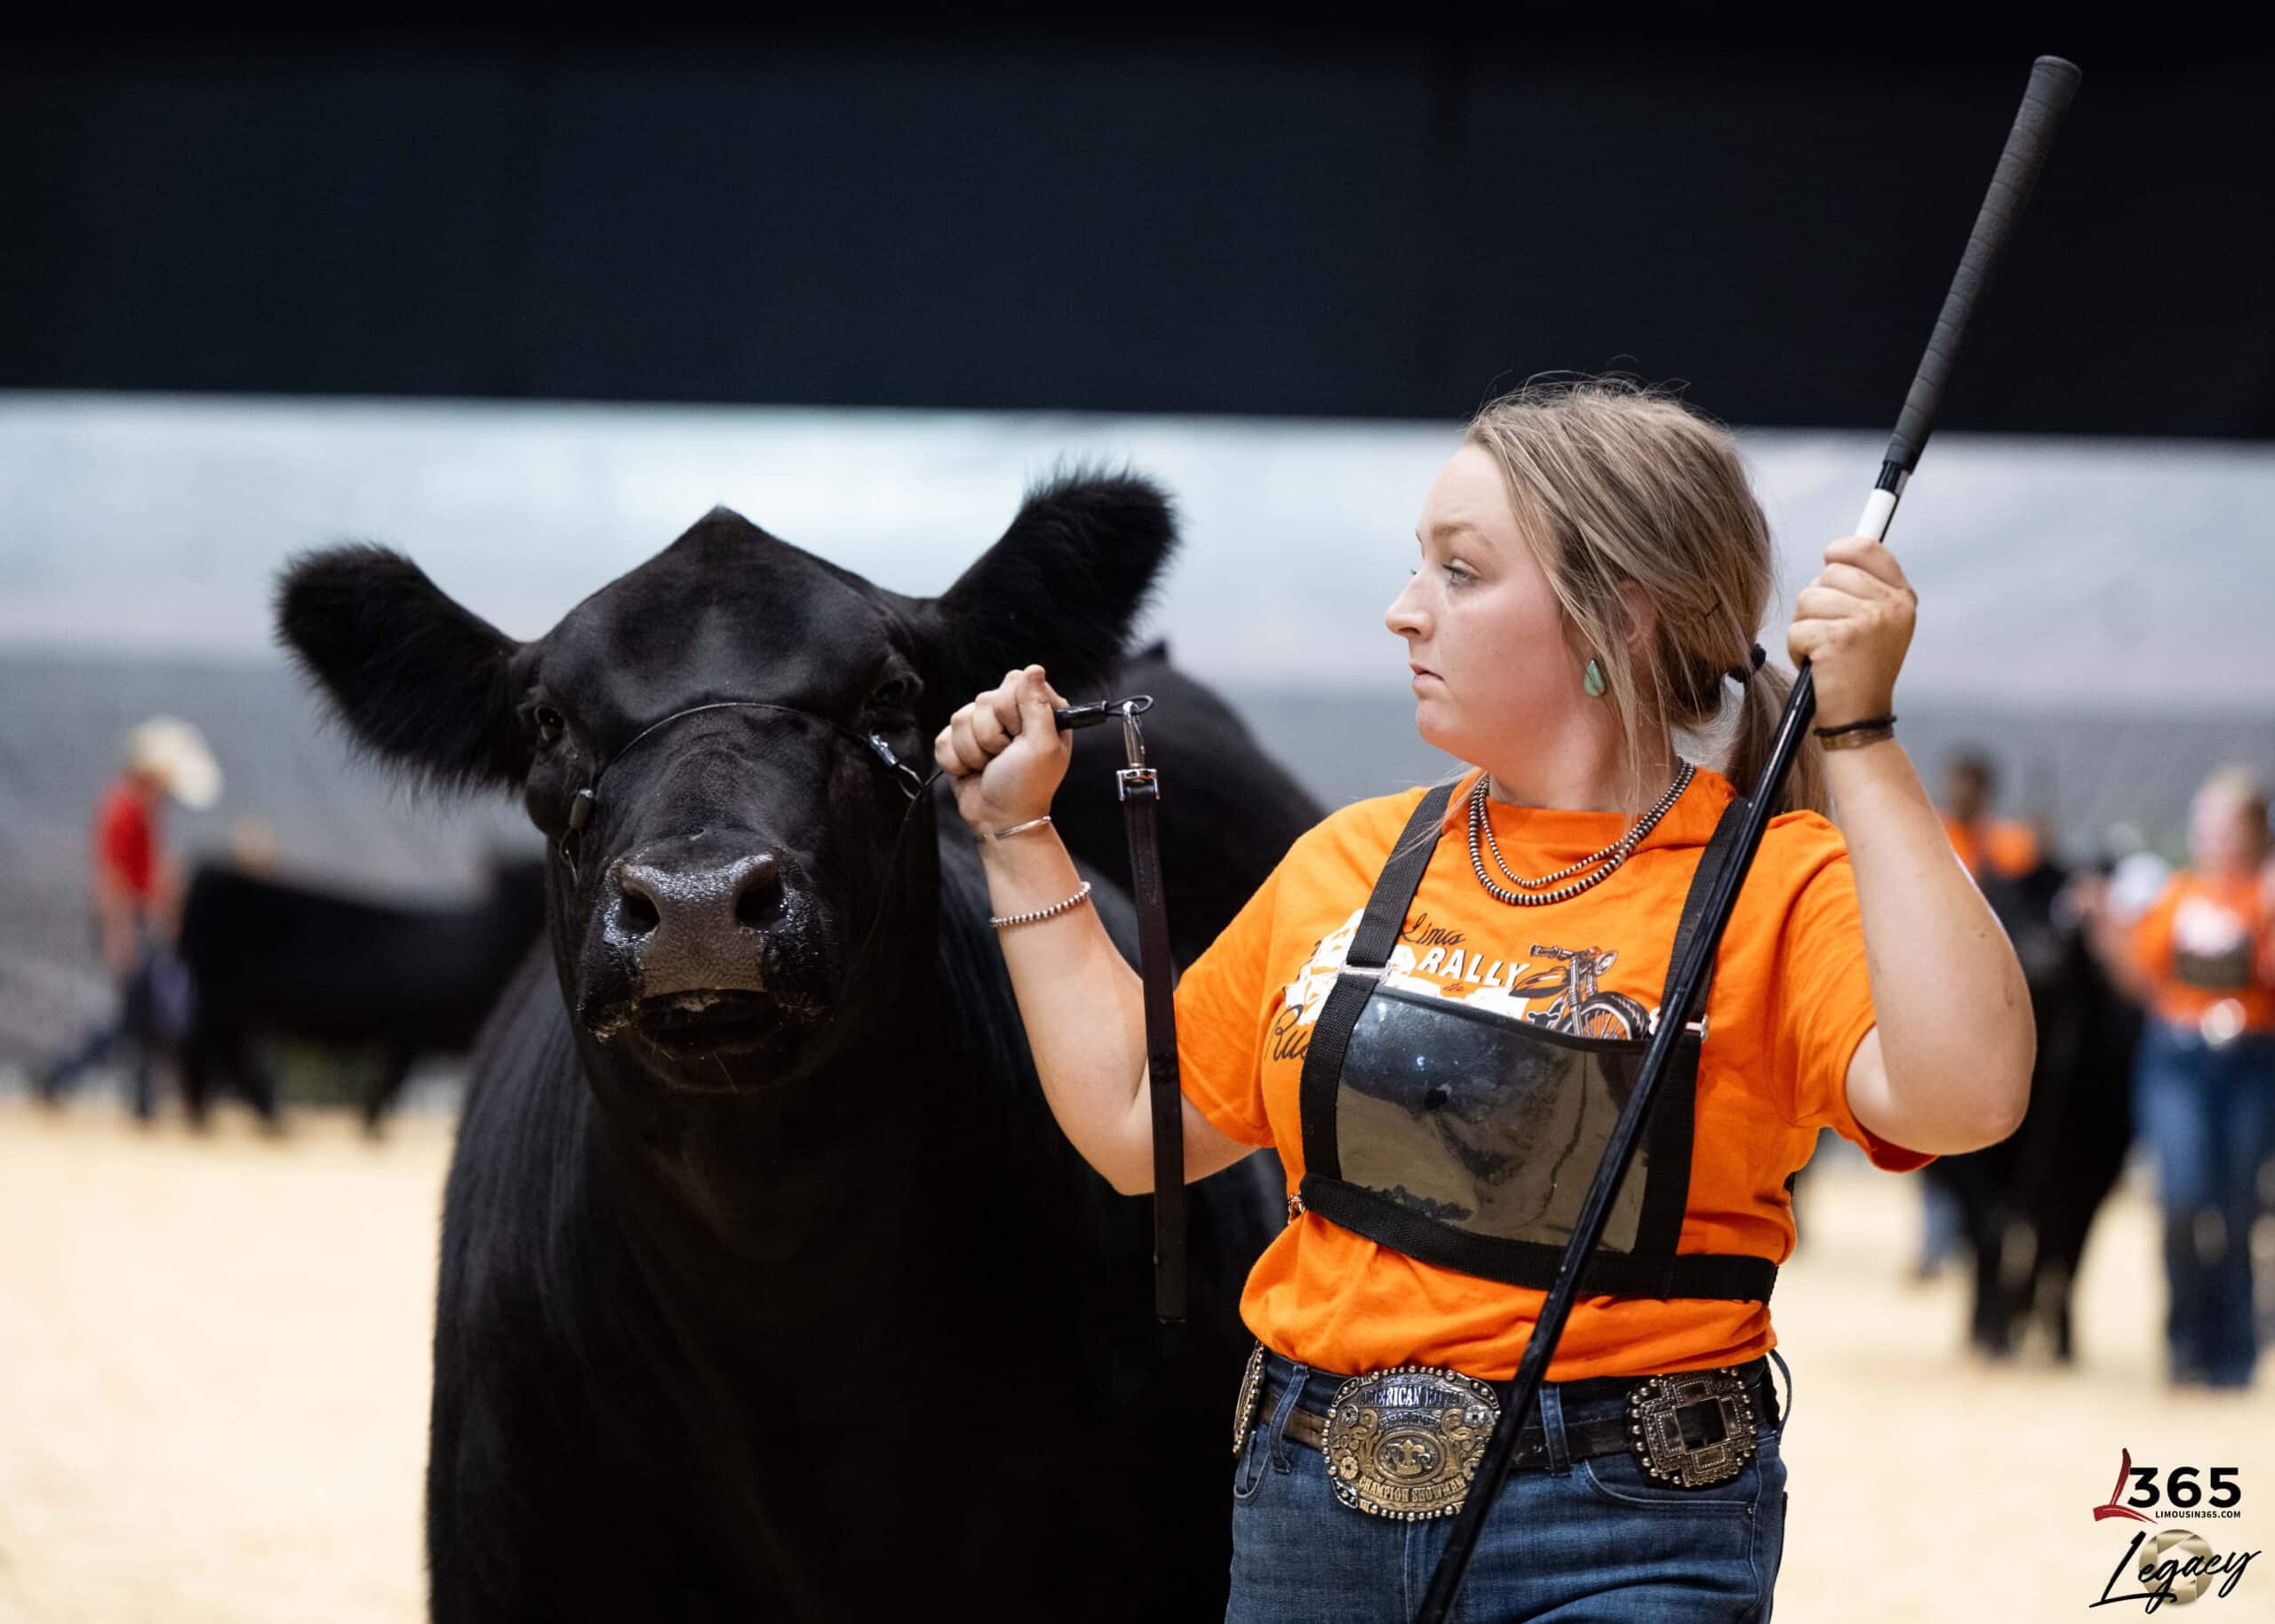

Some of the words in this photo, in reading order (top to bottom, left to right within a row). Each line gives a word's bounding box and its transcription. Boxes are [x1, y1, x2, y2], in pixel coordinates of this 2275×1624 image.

[1417, 946, 1531, 990] RALLY
[1358, 1476, 1409, 1501] CHAMPION
[1411, 1476, 1466, 1501] SHOWMAN
